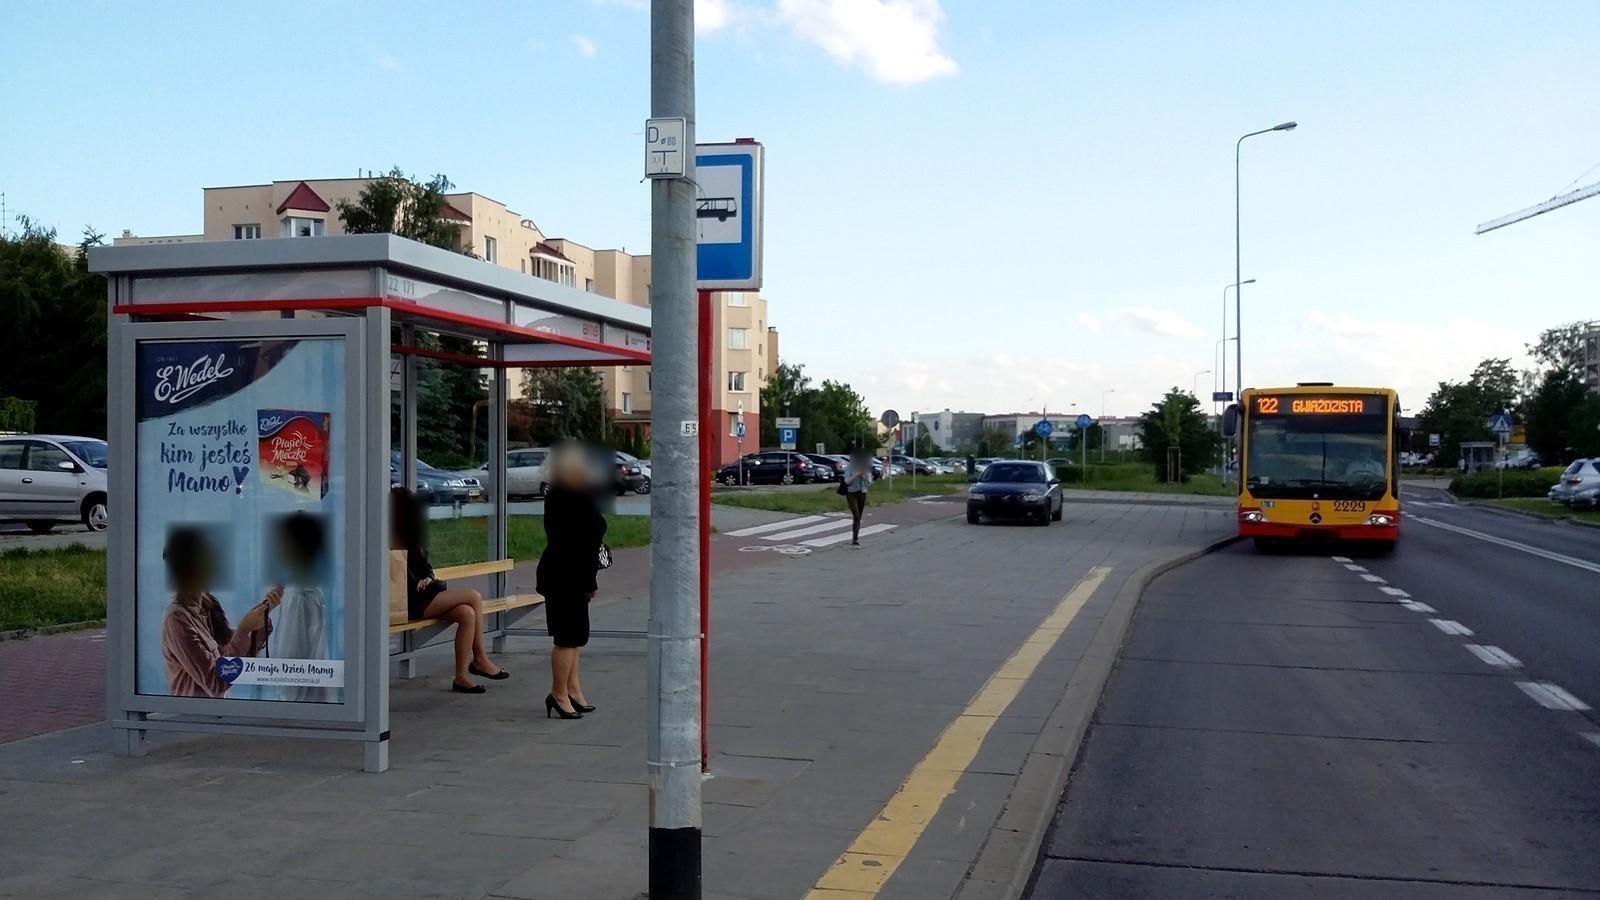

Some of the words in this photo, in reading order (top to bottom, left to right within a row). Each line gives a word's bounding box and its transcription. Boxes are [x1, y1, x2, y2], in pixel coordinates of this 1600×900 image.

[648, 126, 659, 143] D
[154, 353, 234, 403] E.Wedel
[1257, 398, 1278, 413] 122
[168, 422, 184, 436] Za
[189, 420, 248, 440] wszystko
[783, 429, 793, 442] P
[160, 442, 195, 464] kim
[199, 441, 253, 472] jesteś
[1333, 500, 1366, 512] 2229
[245, 661, 256, 673] 26
[258, 663, 279, 676] maja
[282, 663, 305, 674] Dzień
[308, 663, 335, 678] Mamy
